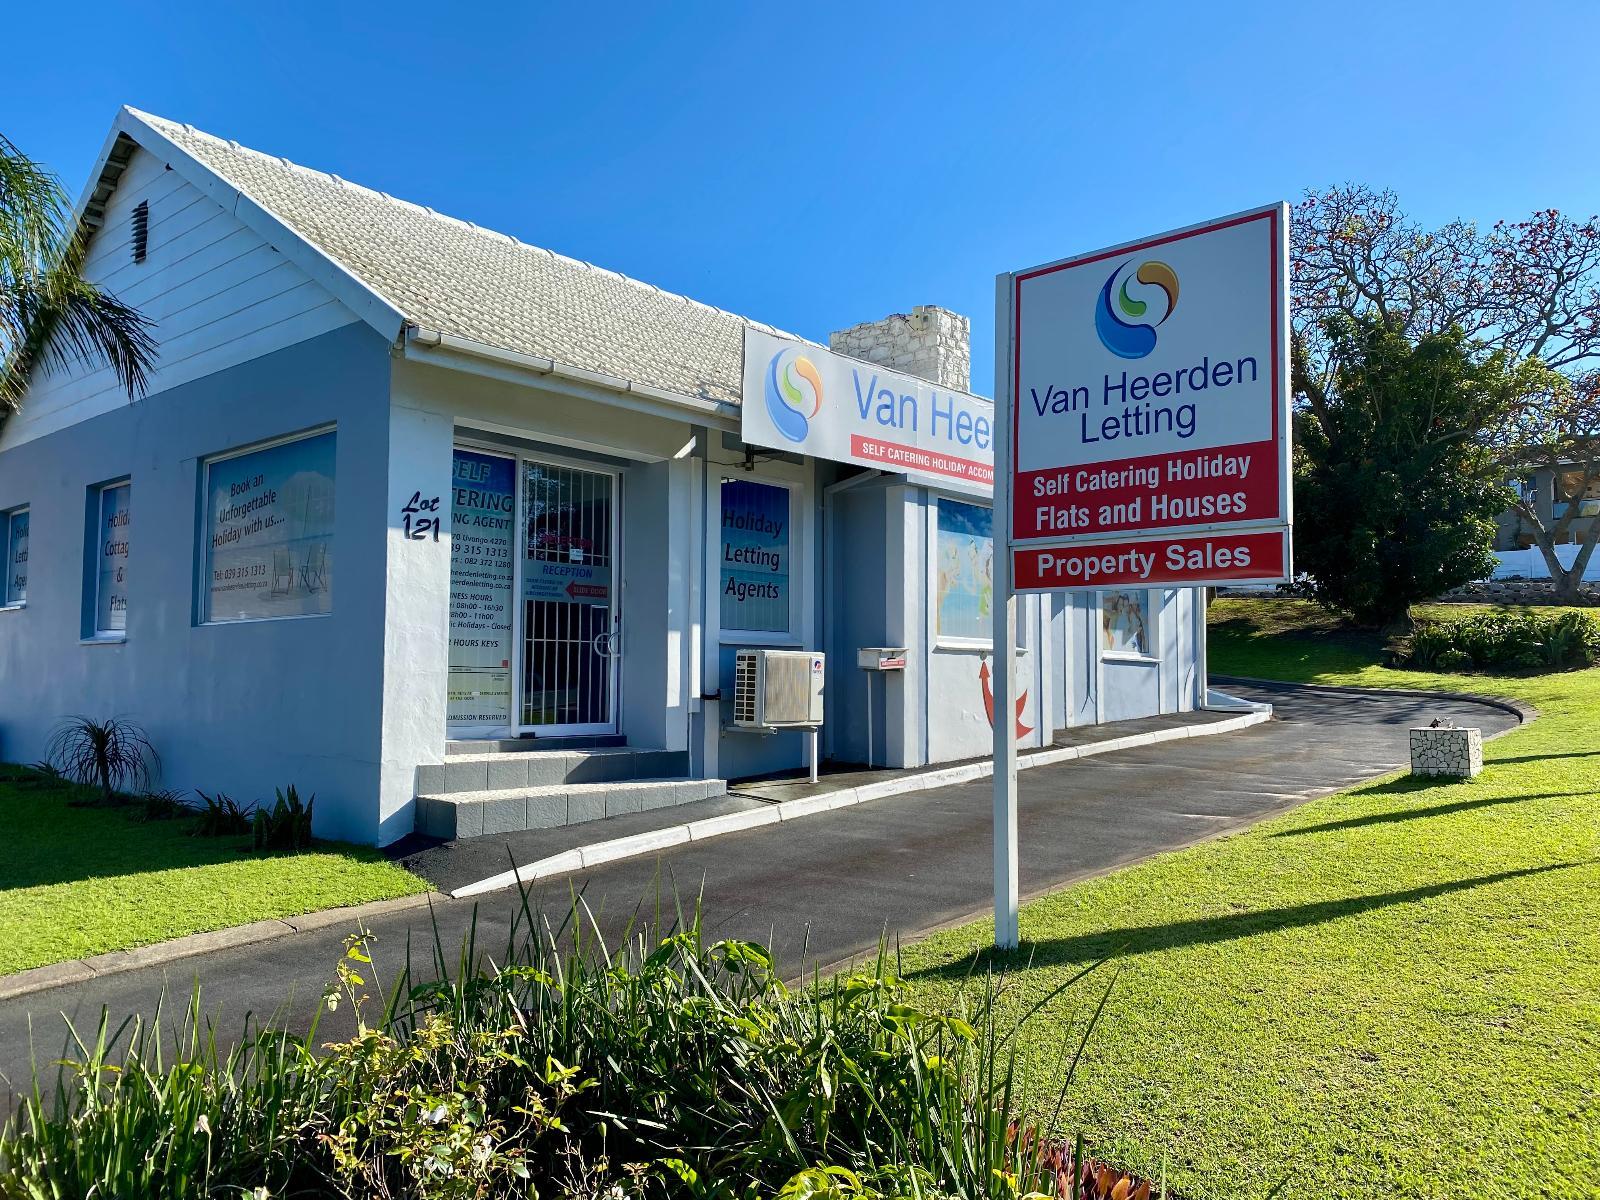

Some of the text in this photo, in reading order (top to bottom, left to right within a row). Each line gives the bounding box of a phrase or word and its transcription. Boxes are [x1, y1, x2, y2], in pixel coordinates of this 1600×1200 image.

[1031, 356, 1257, 417] Van Heerden
[852, 367, 918, 432] Van
[1081, 402, 1196, 444] Letting
[862, 442, 885, 457] SELF
[887, 447, 930, 467] CATERING
[932, 457, 966, 475] HOLIDAY
[231, 474, 264, 498] Book an
[1033, 454, 1251, 497] Self Catering Holiday
[220, 489, 277, 524] Unforgettable
[401, 490, 440, 513] Lot
[1036, 492, 1247, 531] Flats and Houses
[107, 509, 130, 529] Holid
[402, 513, 440, 543] 121
[451, 512, 511, 530] NG AGENT
[722, 508, 782, 539] Holiday
[211, 528, 241, 549] Holiday
[244, 517, 263, 536] with
[489, 538, 507, 546] 4270
[463, 544, 482, 555] 315
[486, 547, 508, 558] 1313
[464, 557, 478, 565] 082
[479, 559, 493, 567] 372
[725, 543, 780, 572] Letting
[1037, 543, 1251, 581] Property Sales
[116, 566, 123, 583] &
[237, 566, 249, 578] 315
[250, 564, 266, 577] 1313
[543, 564, 593, 579] RECEPTION
[470, 593, 493, 602] HOURS
[725, 576, 780, 602] Agents
[458, 620, 486, 630] Holidays
[453, 639, 479, 647] HOURS
[481, 640, 499, 648] KEYS
